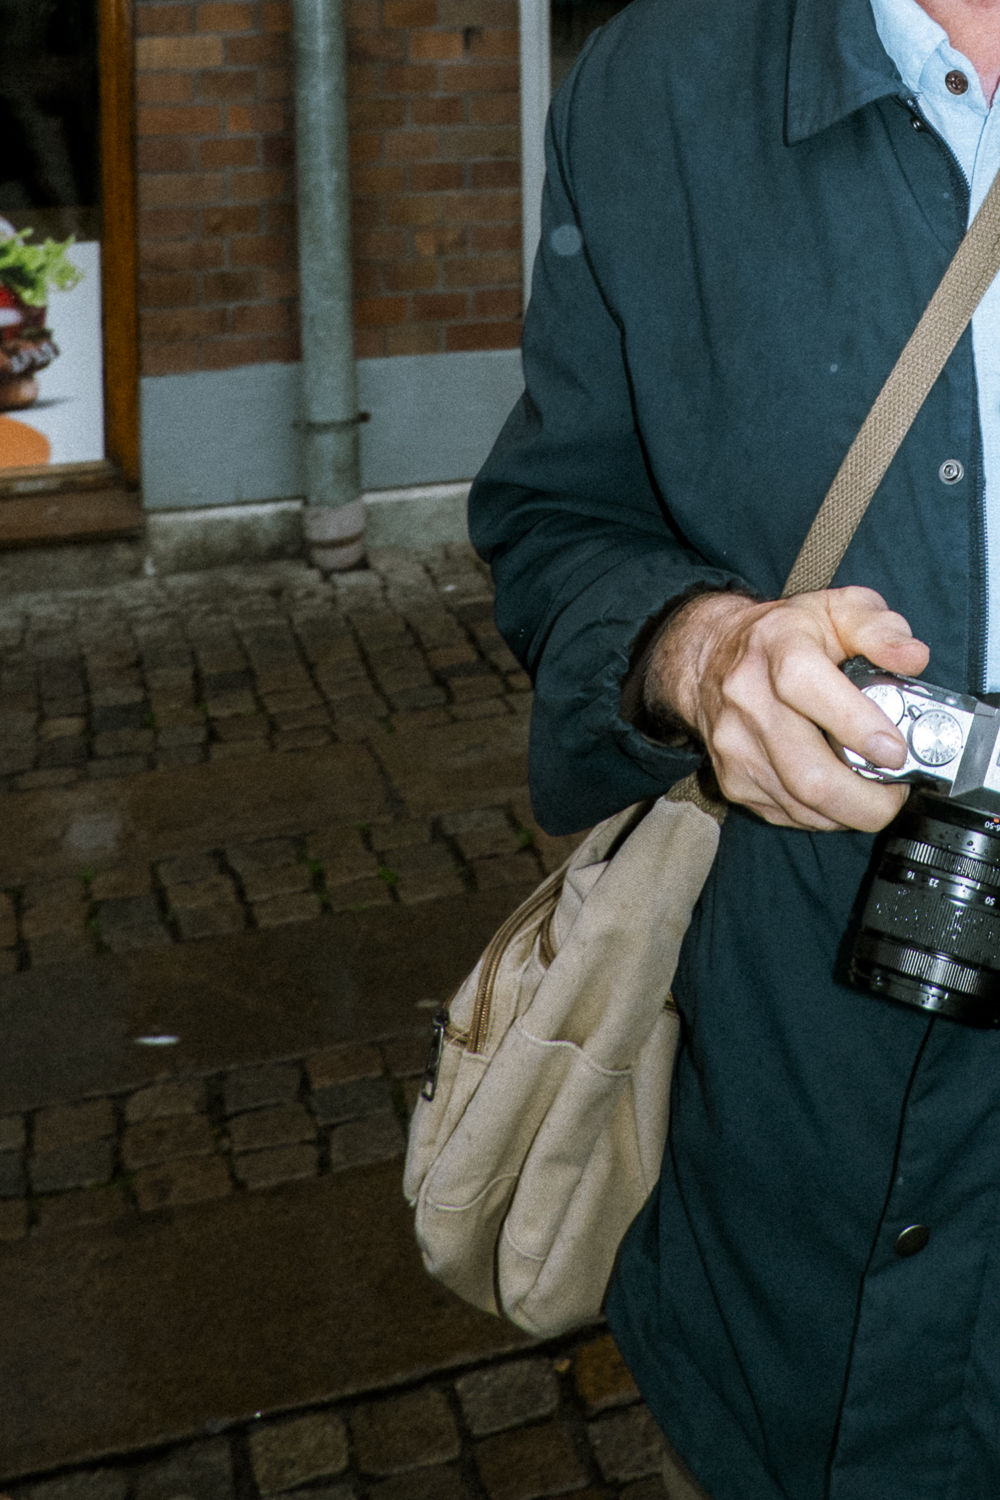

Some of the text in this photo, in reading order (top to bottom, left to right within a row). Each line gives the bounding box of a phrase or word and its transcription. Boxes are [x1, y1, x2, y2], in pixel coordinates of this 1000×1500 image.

[907, 871, 916, 880] 16
[928, 877, 939, 888] 23
[985, 896, 996, 906] 50
